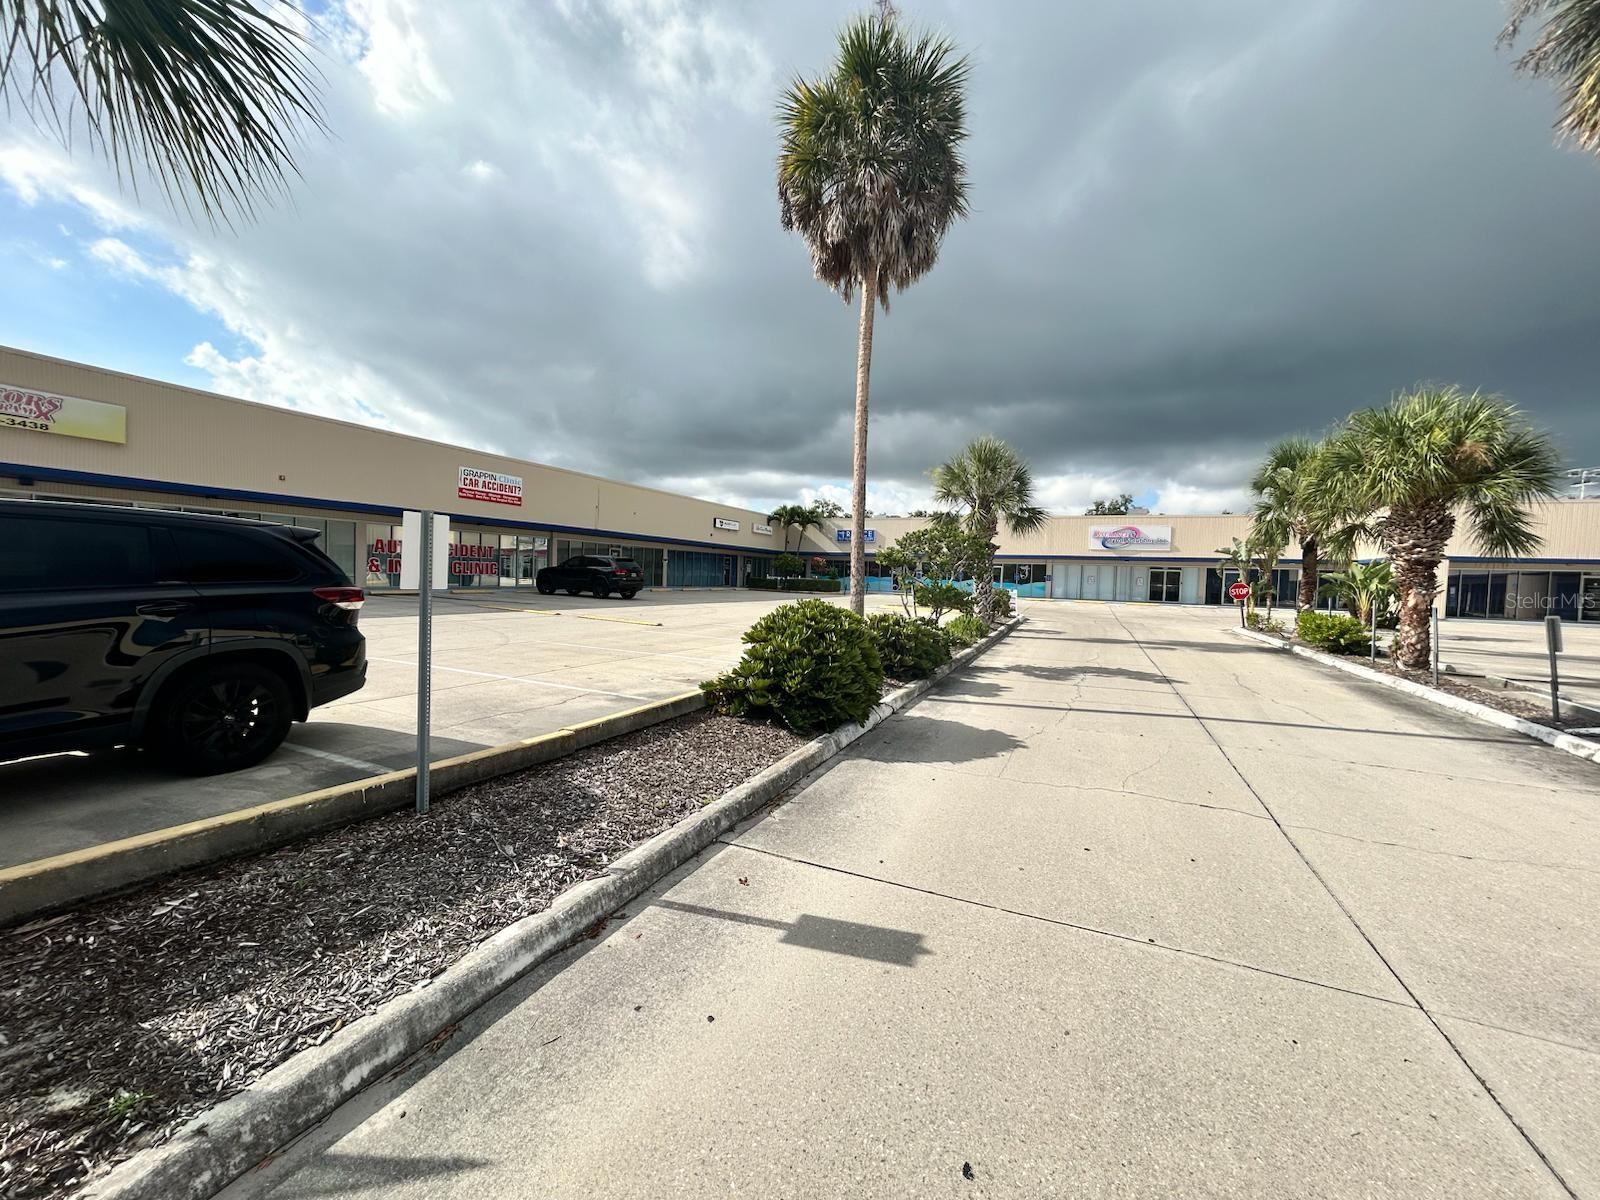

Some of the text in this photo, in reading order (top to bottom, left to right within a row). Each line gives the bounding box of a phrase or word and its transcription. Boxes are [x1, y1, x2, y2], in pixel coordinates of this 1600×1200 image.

[463, 468, 497, 481] GRAPPIN
[463, 477, 480, 489] CAR
[481, 480, 522, 495] ACCIDENT?
[451, 561, 498, 575] CLINIC
[1231, 587, 1249, 595] STOP
